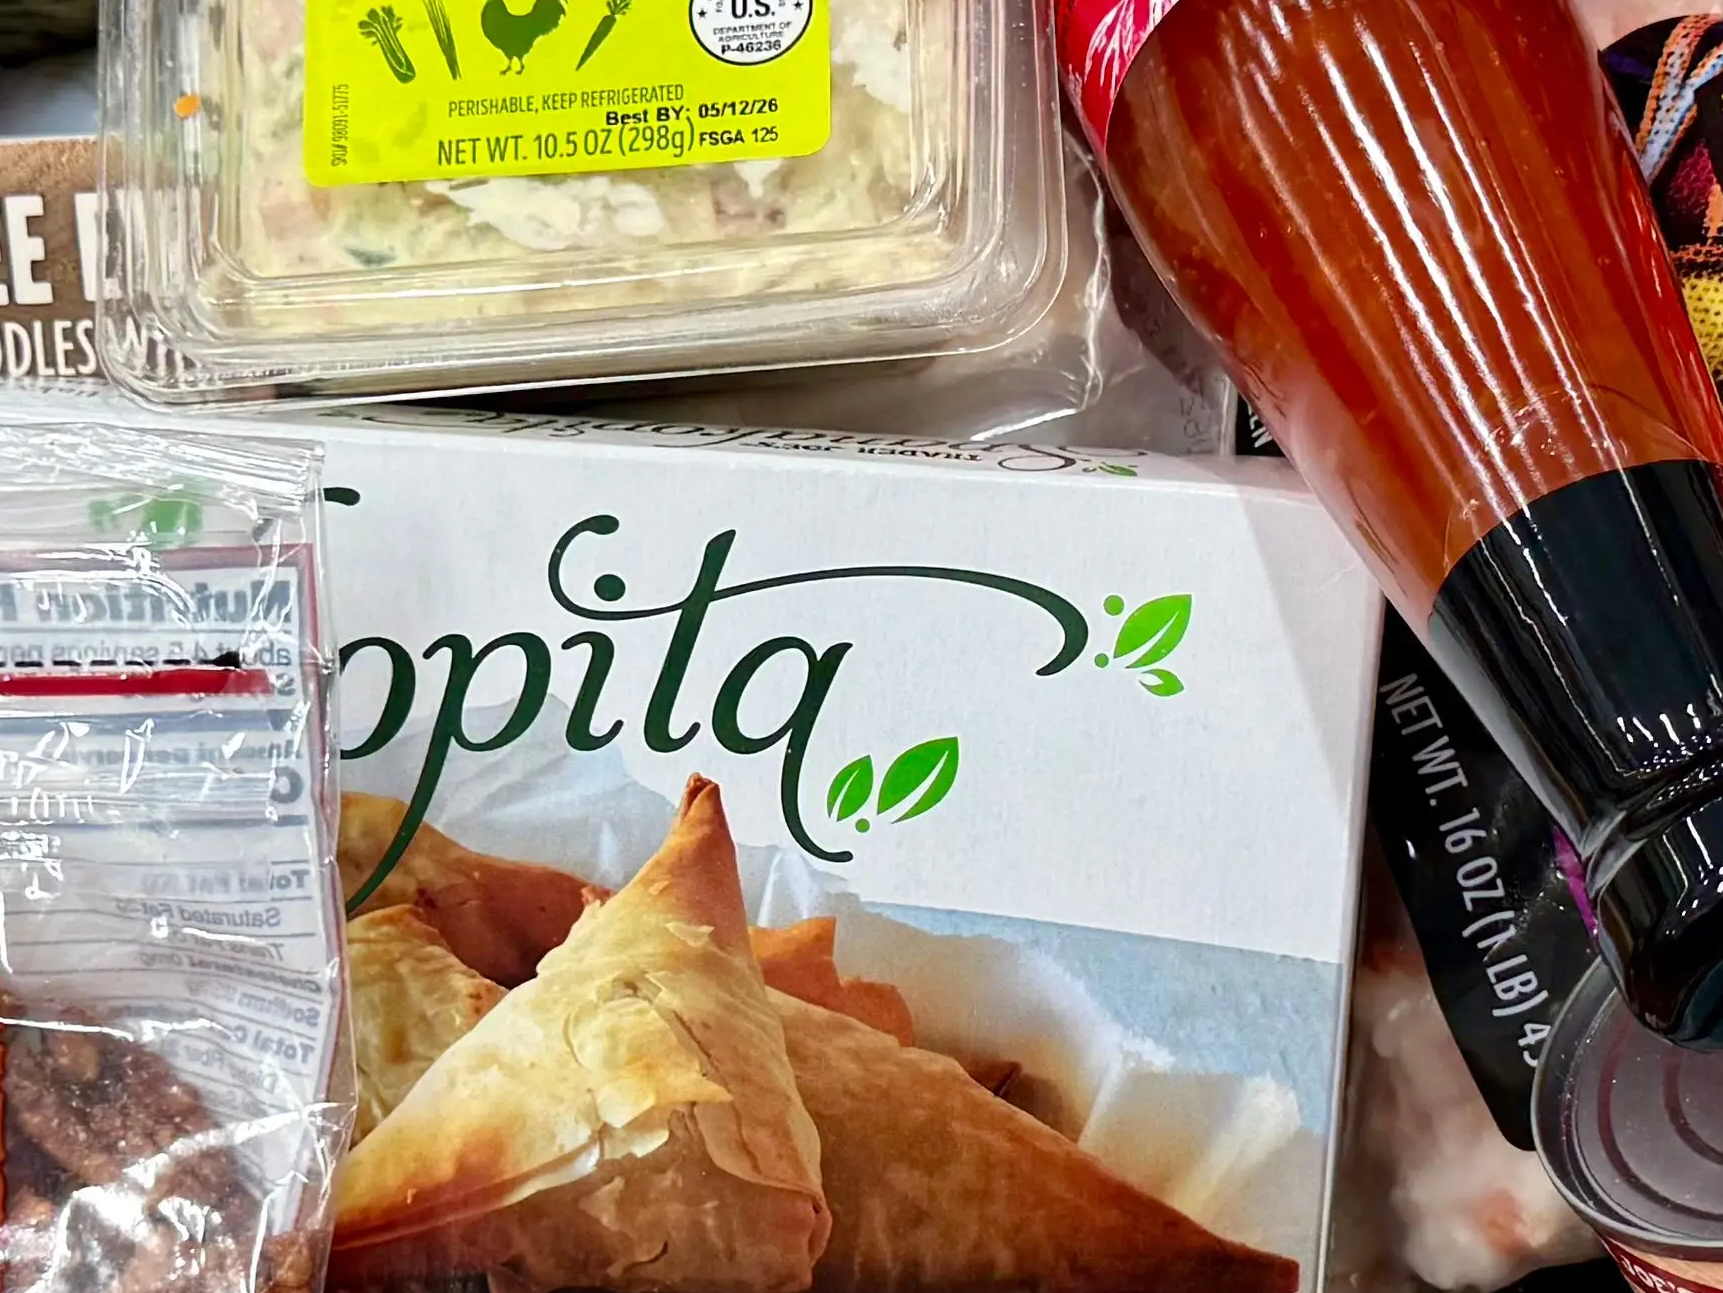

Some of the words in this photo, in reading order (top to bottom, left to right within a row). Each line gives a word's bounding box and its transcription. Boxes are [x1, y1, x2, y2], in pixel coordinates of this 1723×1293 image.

[713, 21, 776, 36] DEPARTMENT
[448, 95, 539, 118] PERISHABLE,
[542, 90, 578, 112] KEEP
[580, 84, 685, 109] REFRIGERATED
[606, 108, 649, 126] Best
[657, 106, 690, 123] BY:
[698, 97, 779, 120] 05/12/26
[437, 137, 481, 167] NET
[487, 134, 528, 164] WT.
[533, 130, 578, 160] 10.5
[584, 126, 613, 155] OZ
[618, 115, 695, 158] (298g)
[699, 129, 745, 147] FSGA
[751, 126, 779, 144] 125
[1378, 672, 1444, 737] NET
[1411, 734, 1469, 807] WT.
[1438, 806, 1487, 856] 16
[1455, 855, 1506, 913] OZ
[1461, 909, 1517, 954] (1
[1485, 953, 1550, 1018] LB)
